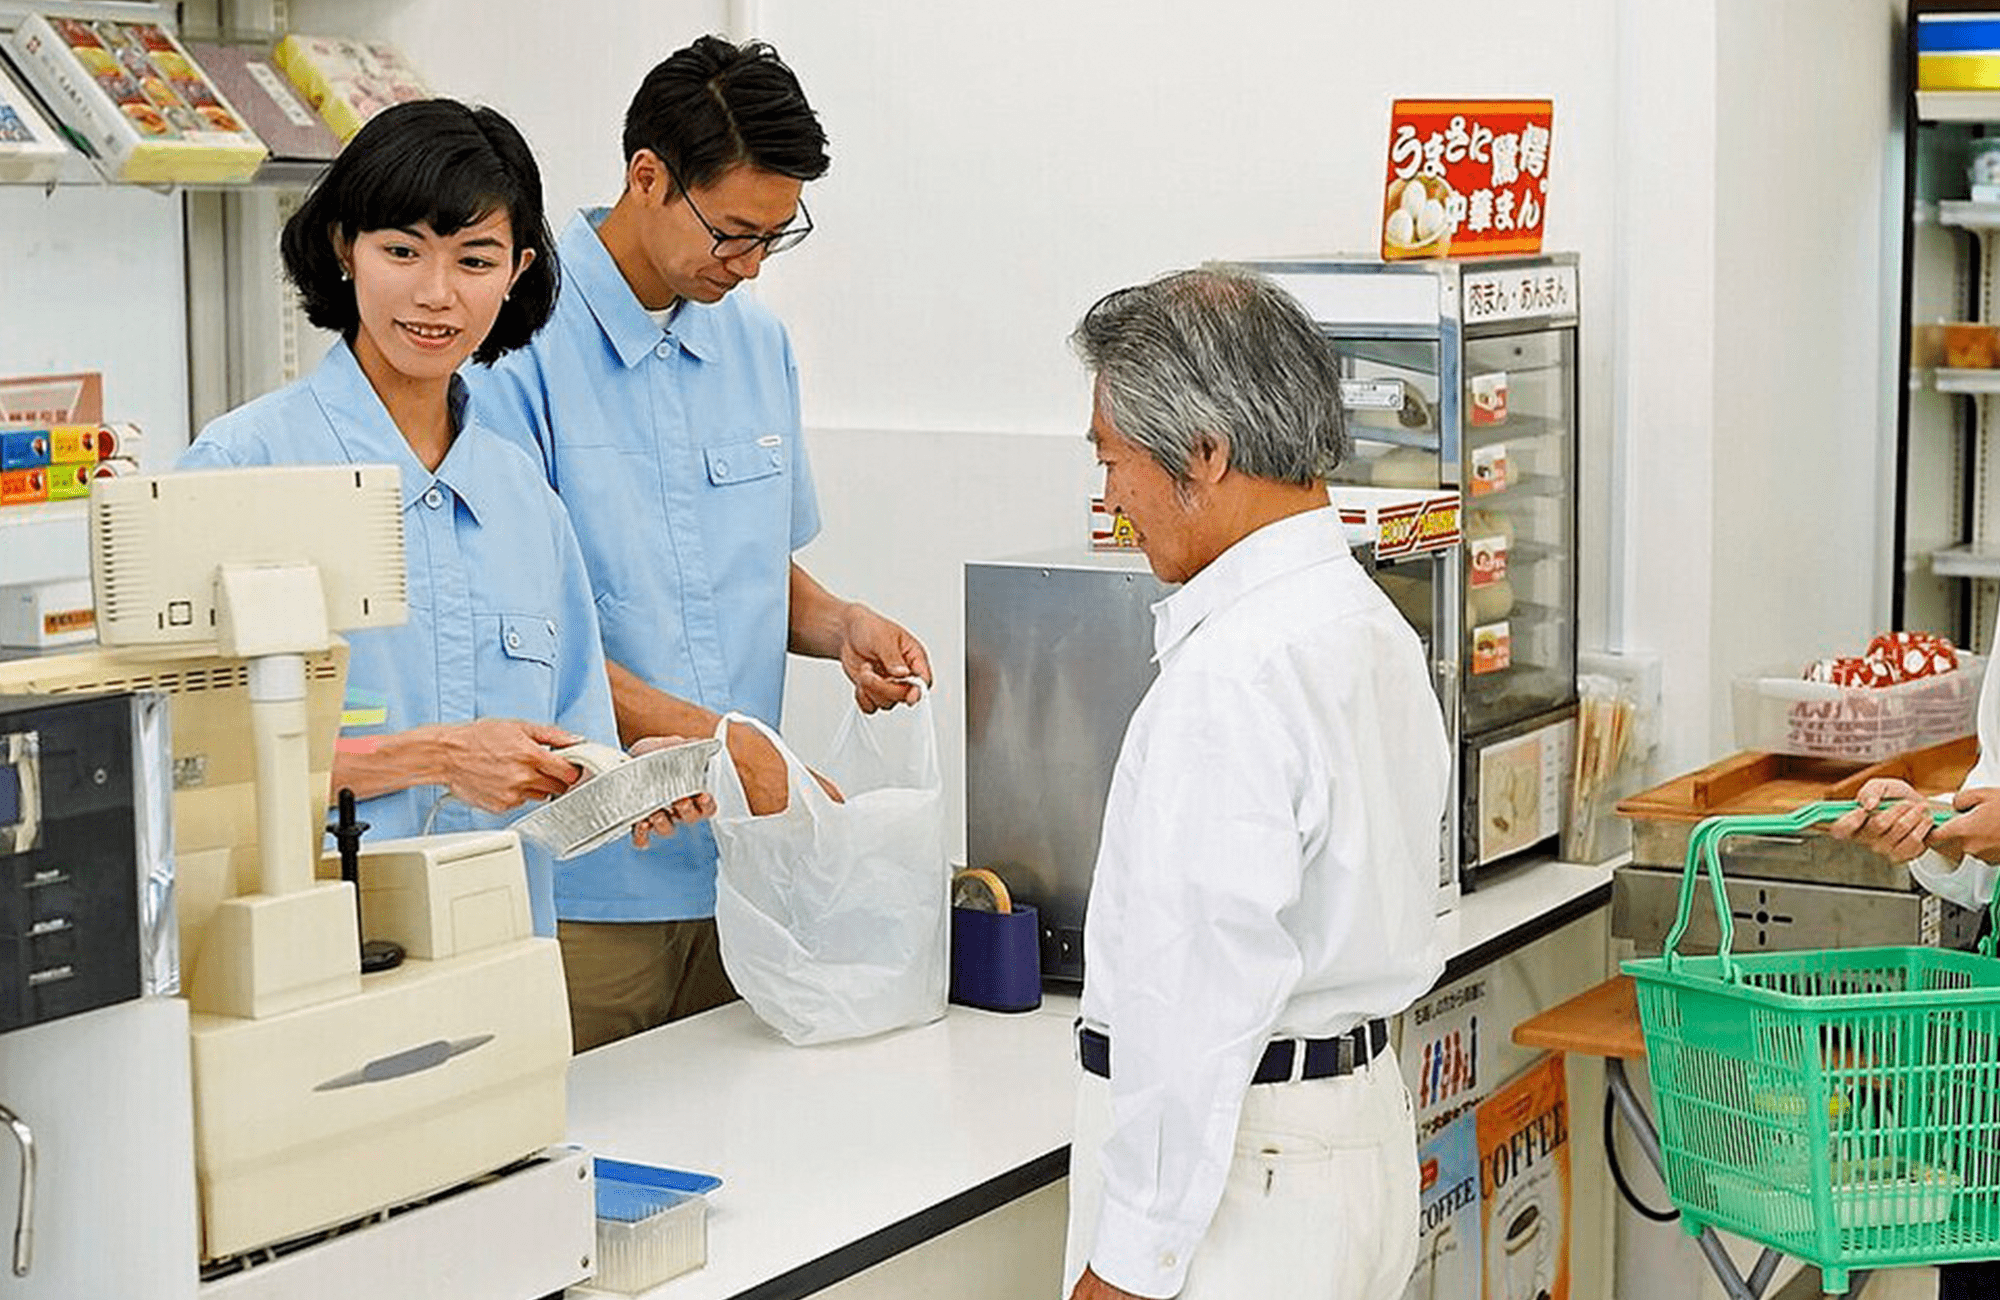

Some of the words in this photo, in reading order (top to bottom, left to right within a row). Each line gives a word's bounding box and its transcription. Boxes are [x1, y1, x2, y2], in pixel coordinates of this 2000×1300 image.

[1445, 187, 1541, 234] 中華まん
[1469, 276, 1567, 317] 肉まん・あんまん
[1480, 1099, 1568, 1200] COFFEE
[1419, 1177, 1477, 1238] COFFEE
